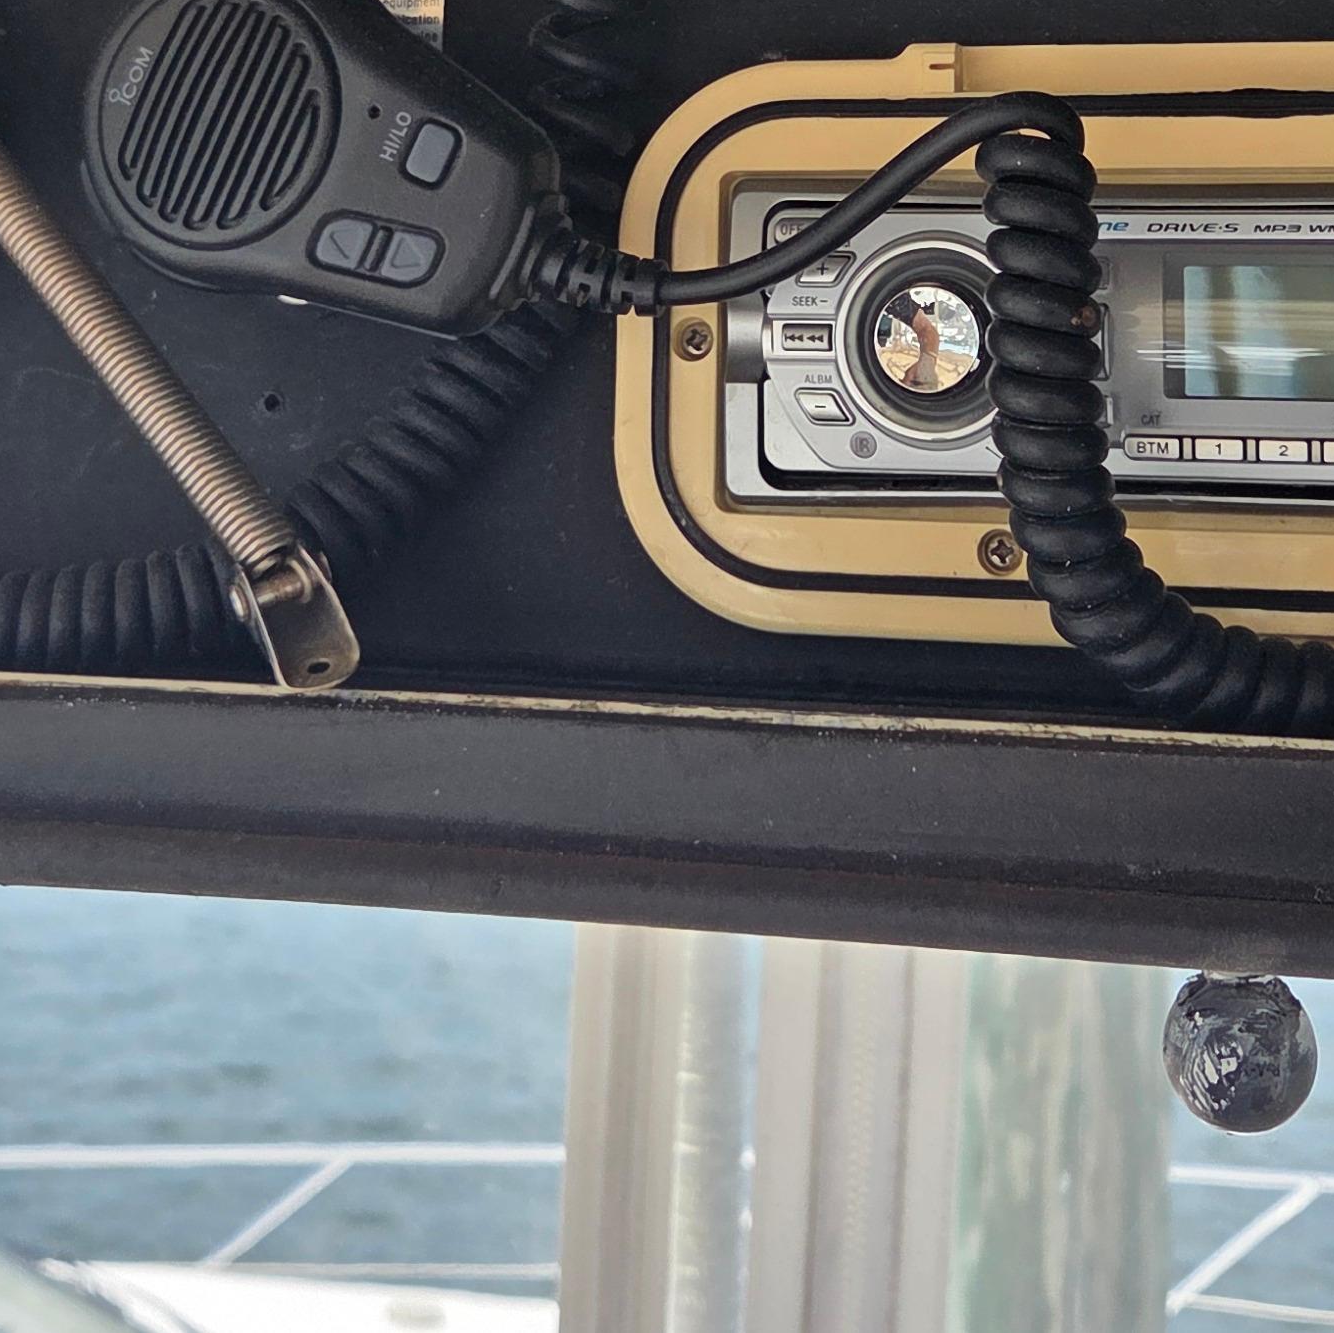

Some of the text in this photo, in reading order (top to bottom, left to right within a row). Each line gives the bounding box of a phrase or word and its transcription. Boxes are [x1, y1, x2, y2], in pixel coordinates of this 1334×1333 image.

[379, 111, 412, 162] HI/LO
[1253, 223, 1303, 233] MP3
[791, 296, 818, 307] SEEK
[804, 374, 833, 385] ALBM
[1140, 414, 1161, 427] CAT
[1136, 442, 1169, 455] BTM
[1215, 442, 1223, 455] 1
[1278, 445, 1289, 457] 2
